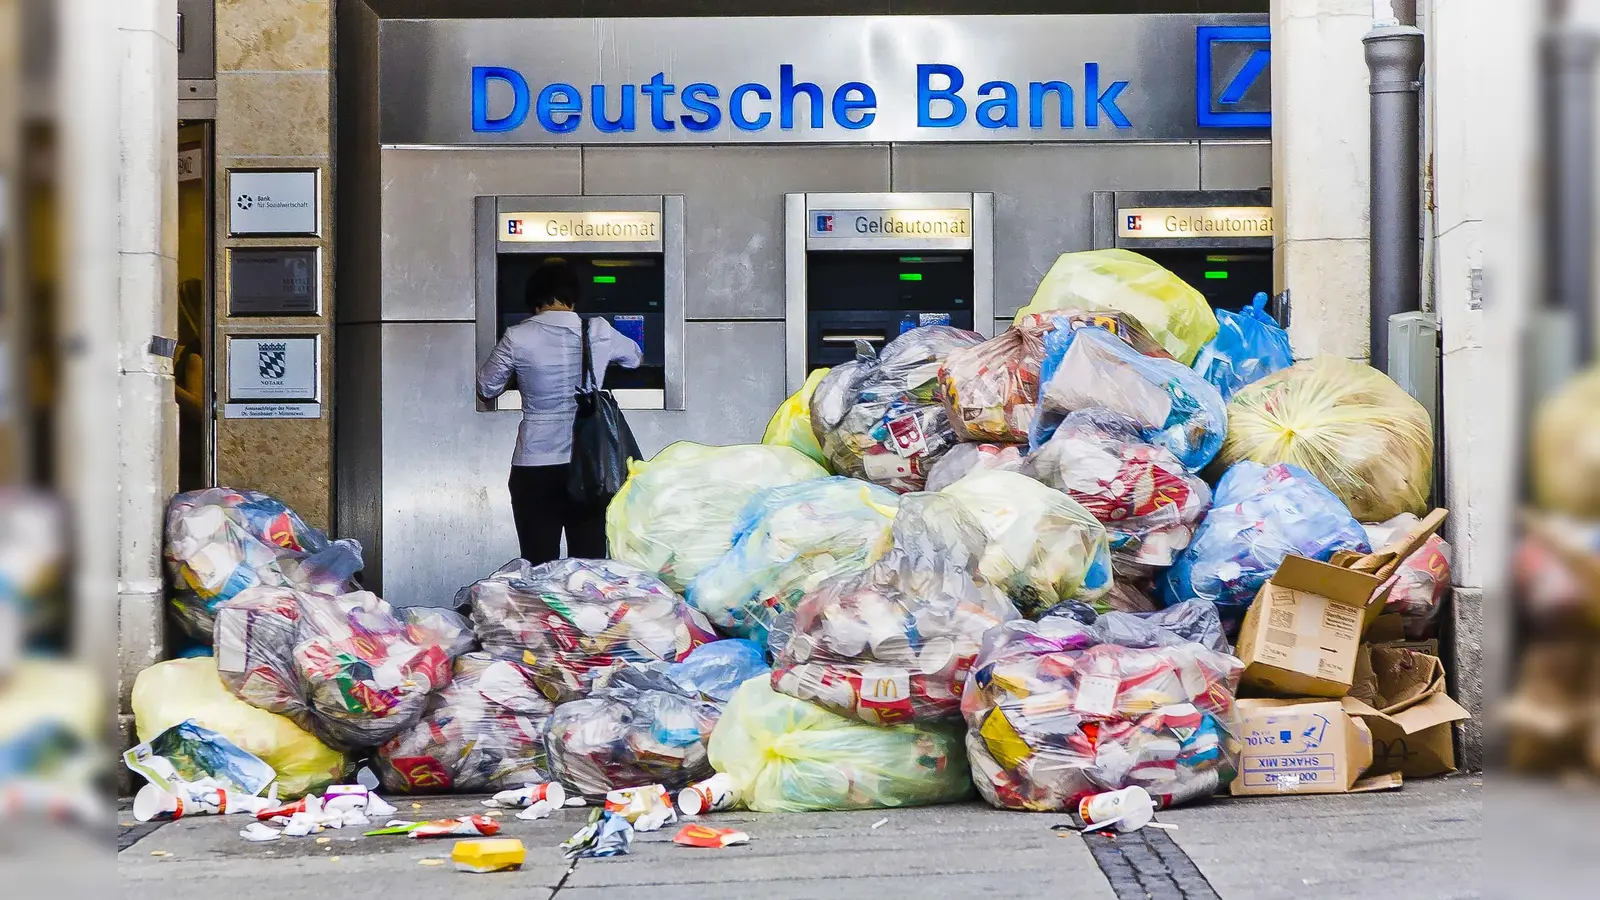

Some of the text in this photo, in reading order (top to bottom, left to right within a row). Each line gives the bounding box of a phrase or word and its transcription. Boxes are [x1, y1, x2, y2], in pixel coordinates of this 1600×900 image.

[471, 62, 1133, 134] Deutsche Bank
[546, 219, 656, 237] Geldautomat
[855, 216, 966, 234] Geldautomat
[1165, 215, 1274, 232] Geldautomat
[1259, 756, 1320, 768] SHAKE MIX
